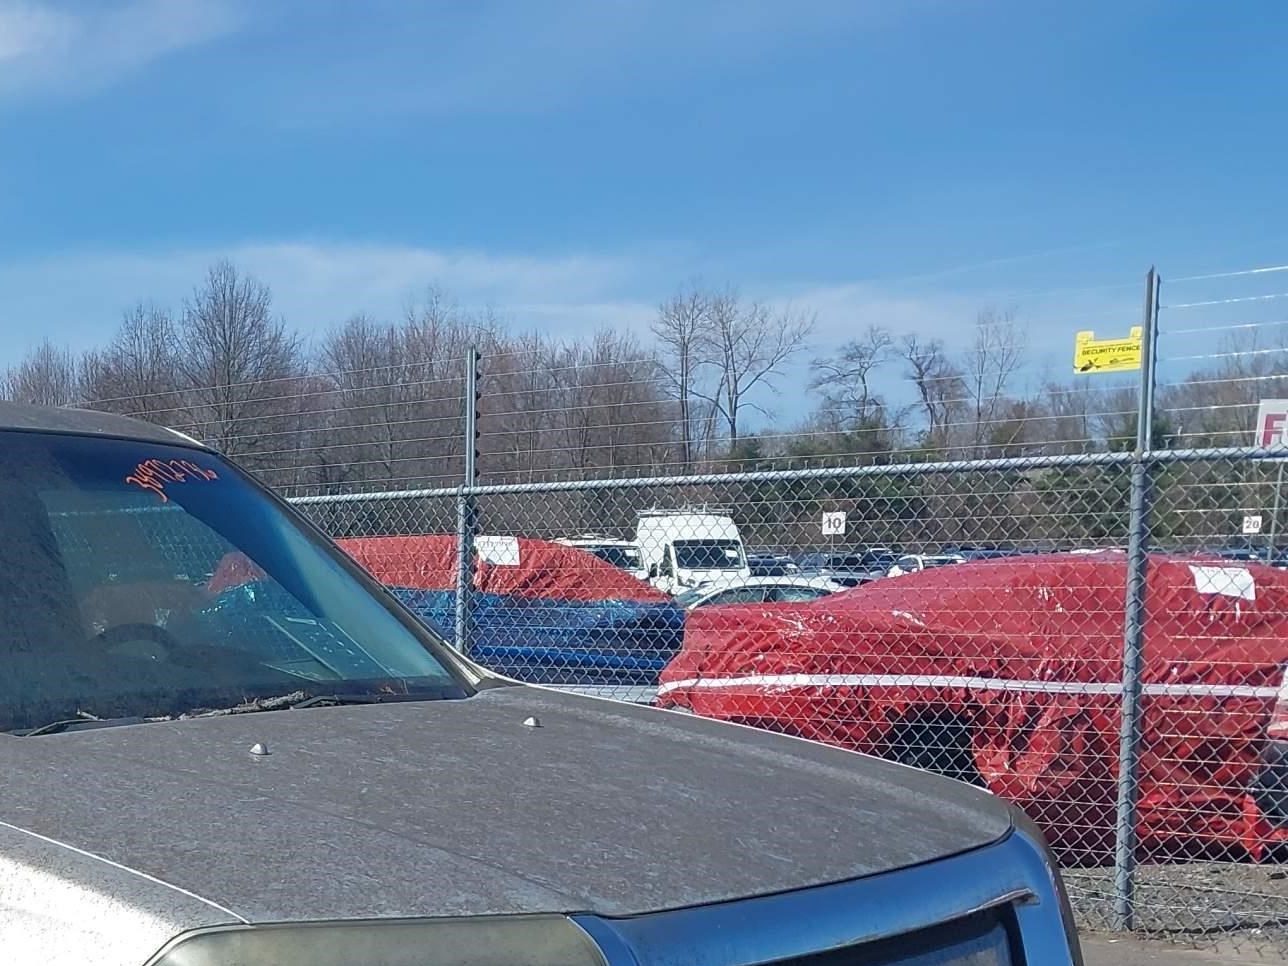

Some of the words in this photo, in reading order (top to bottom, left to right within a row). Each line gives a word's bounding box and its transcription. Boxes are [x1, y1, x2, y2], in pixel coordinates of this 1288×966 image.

[1082, 347, 1117, 356] SECURITY
[1117, 344, 1141, 353] FENCE
[827, 517, 842, 529] 10
[1245, 519, 1260, 529] 20
